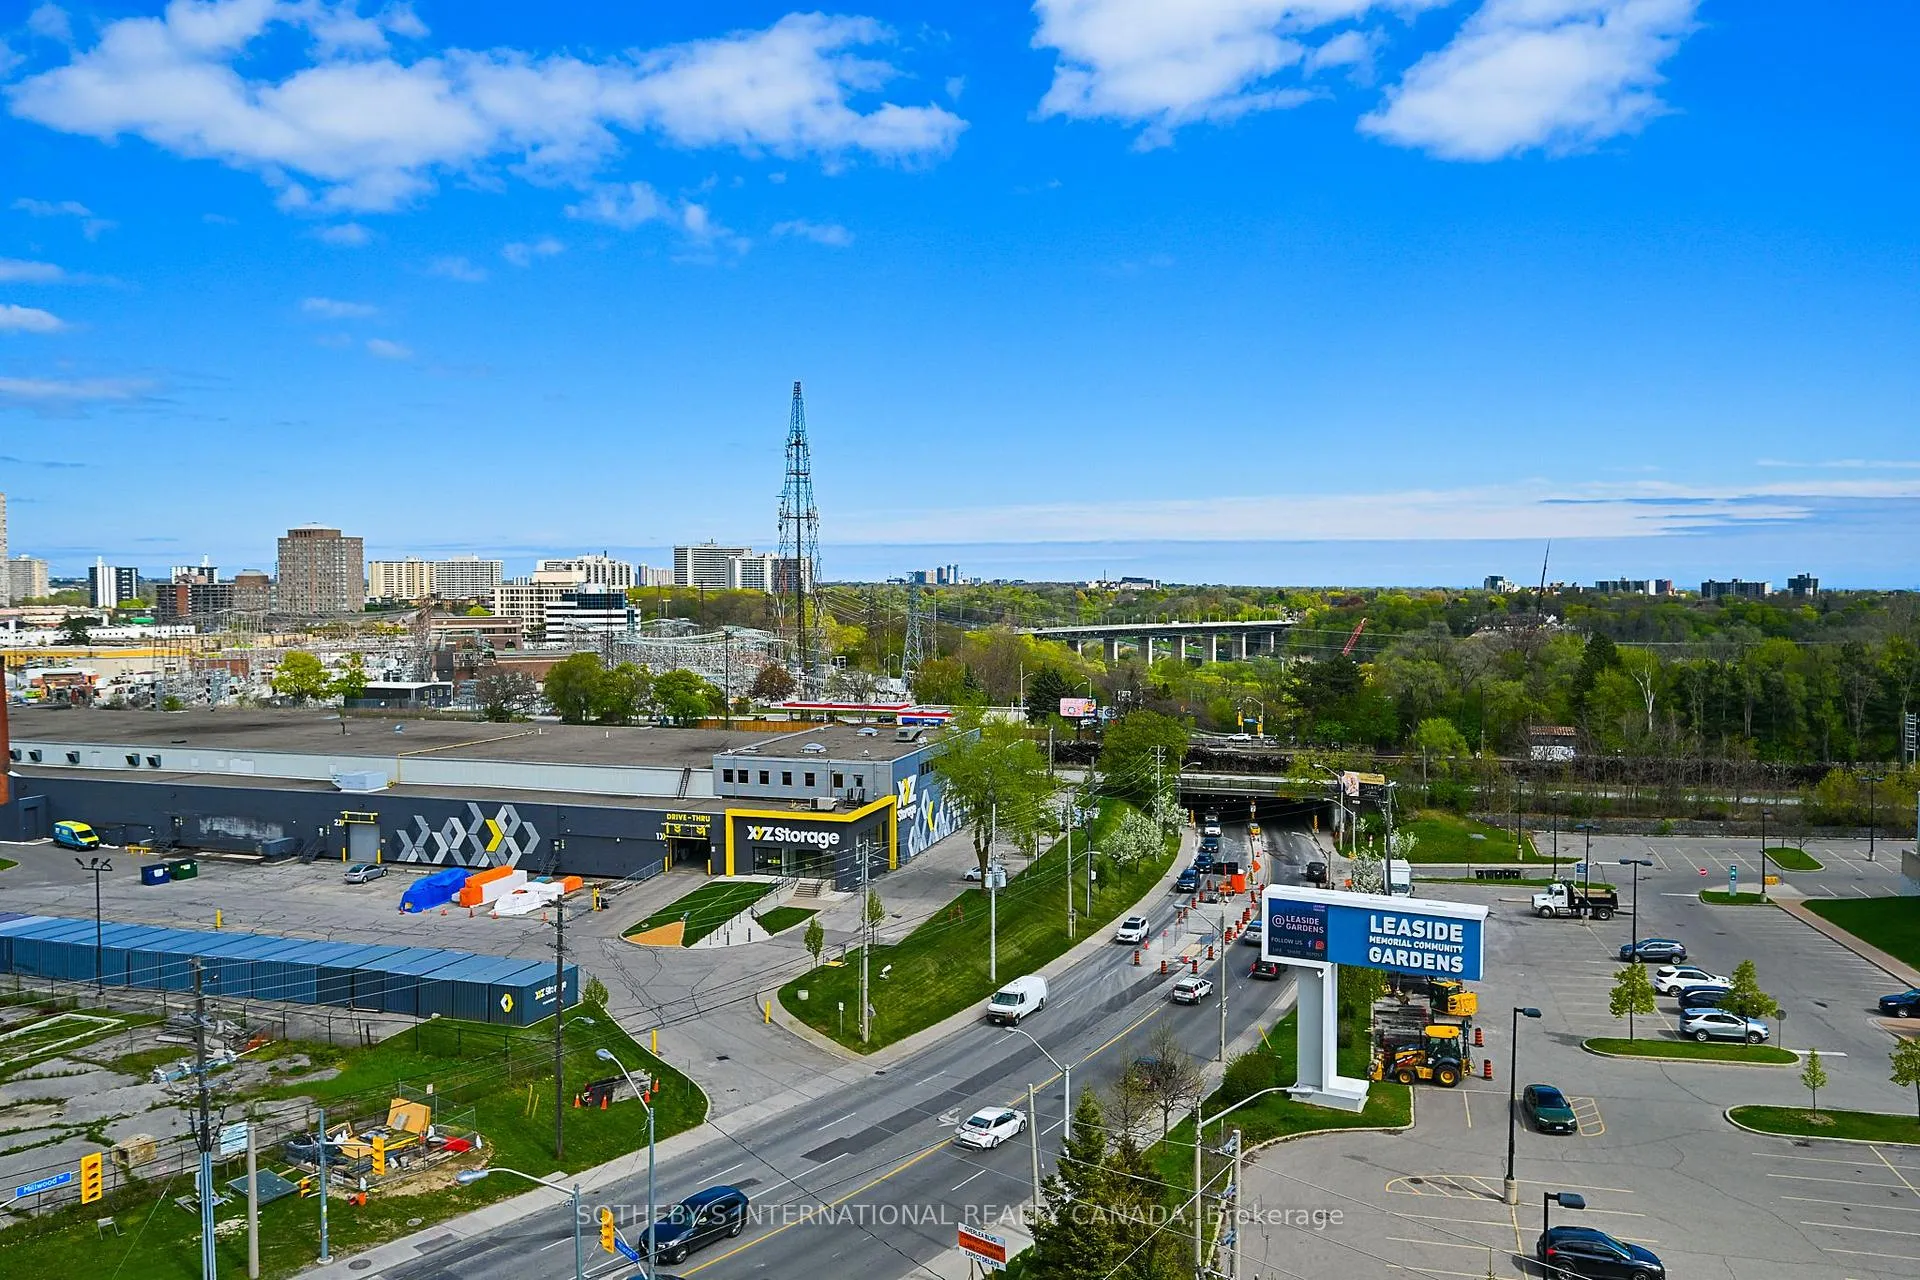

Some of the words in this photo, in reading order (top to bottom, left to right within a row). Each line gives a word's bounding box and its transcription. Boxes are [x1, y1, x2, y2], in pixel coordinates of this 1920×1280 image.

[666, 813, 711, 823] DRIVE-THRU
[1286, 915, 1320, 926] LEASIDE
[1285, 923, 1325, 934] GARDENS
[1370, 915, 1464, 943] LEASIDE
[1271, 936, 1294, 945] FOLLOW
[1369, 935, 1412, 948] MEMORIAL
[1413, 941, 1464, 954] COMMUNITY
[1369, 946, 1464, 973] GARDENS
[23, 1178, 58, 1193] Millwood
[964, 1226, 984, 1239] OVERLEA
